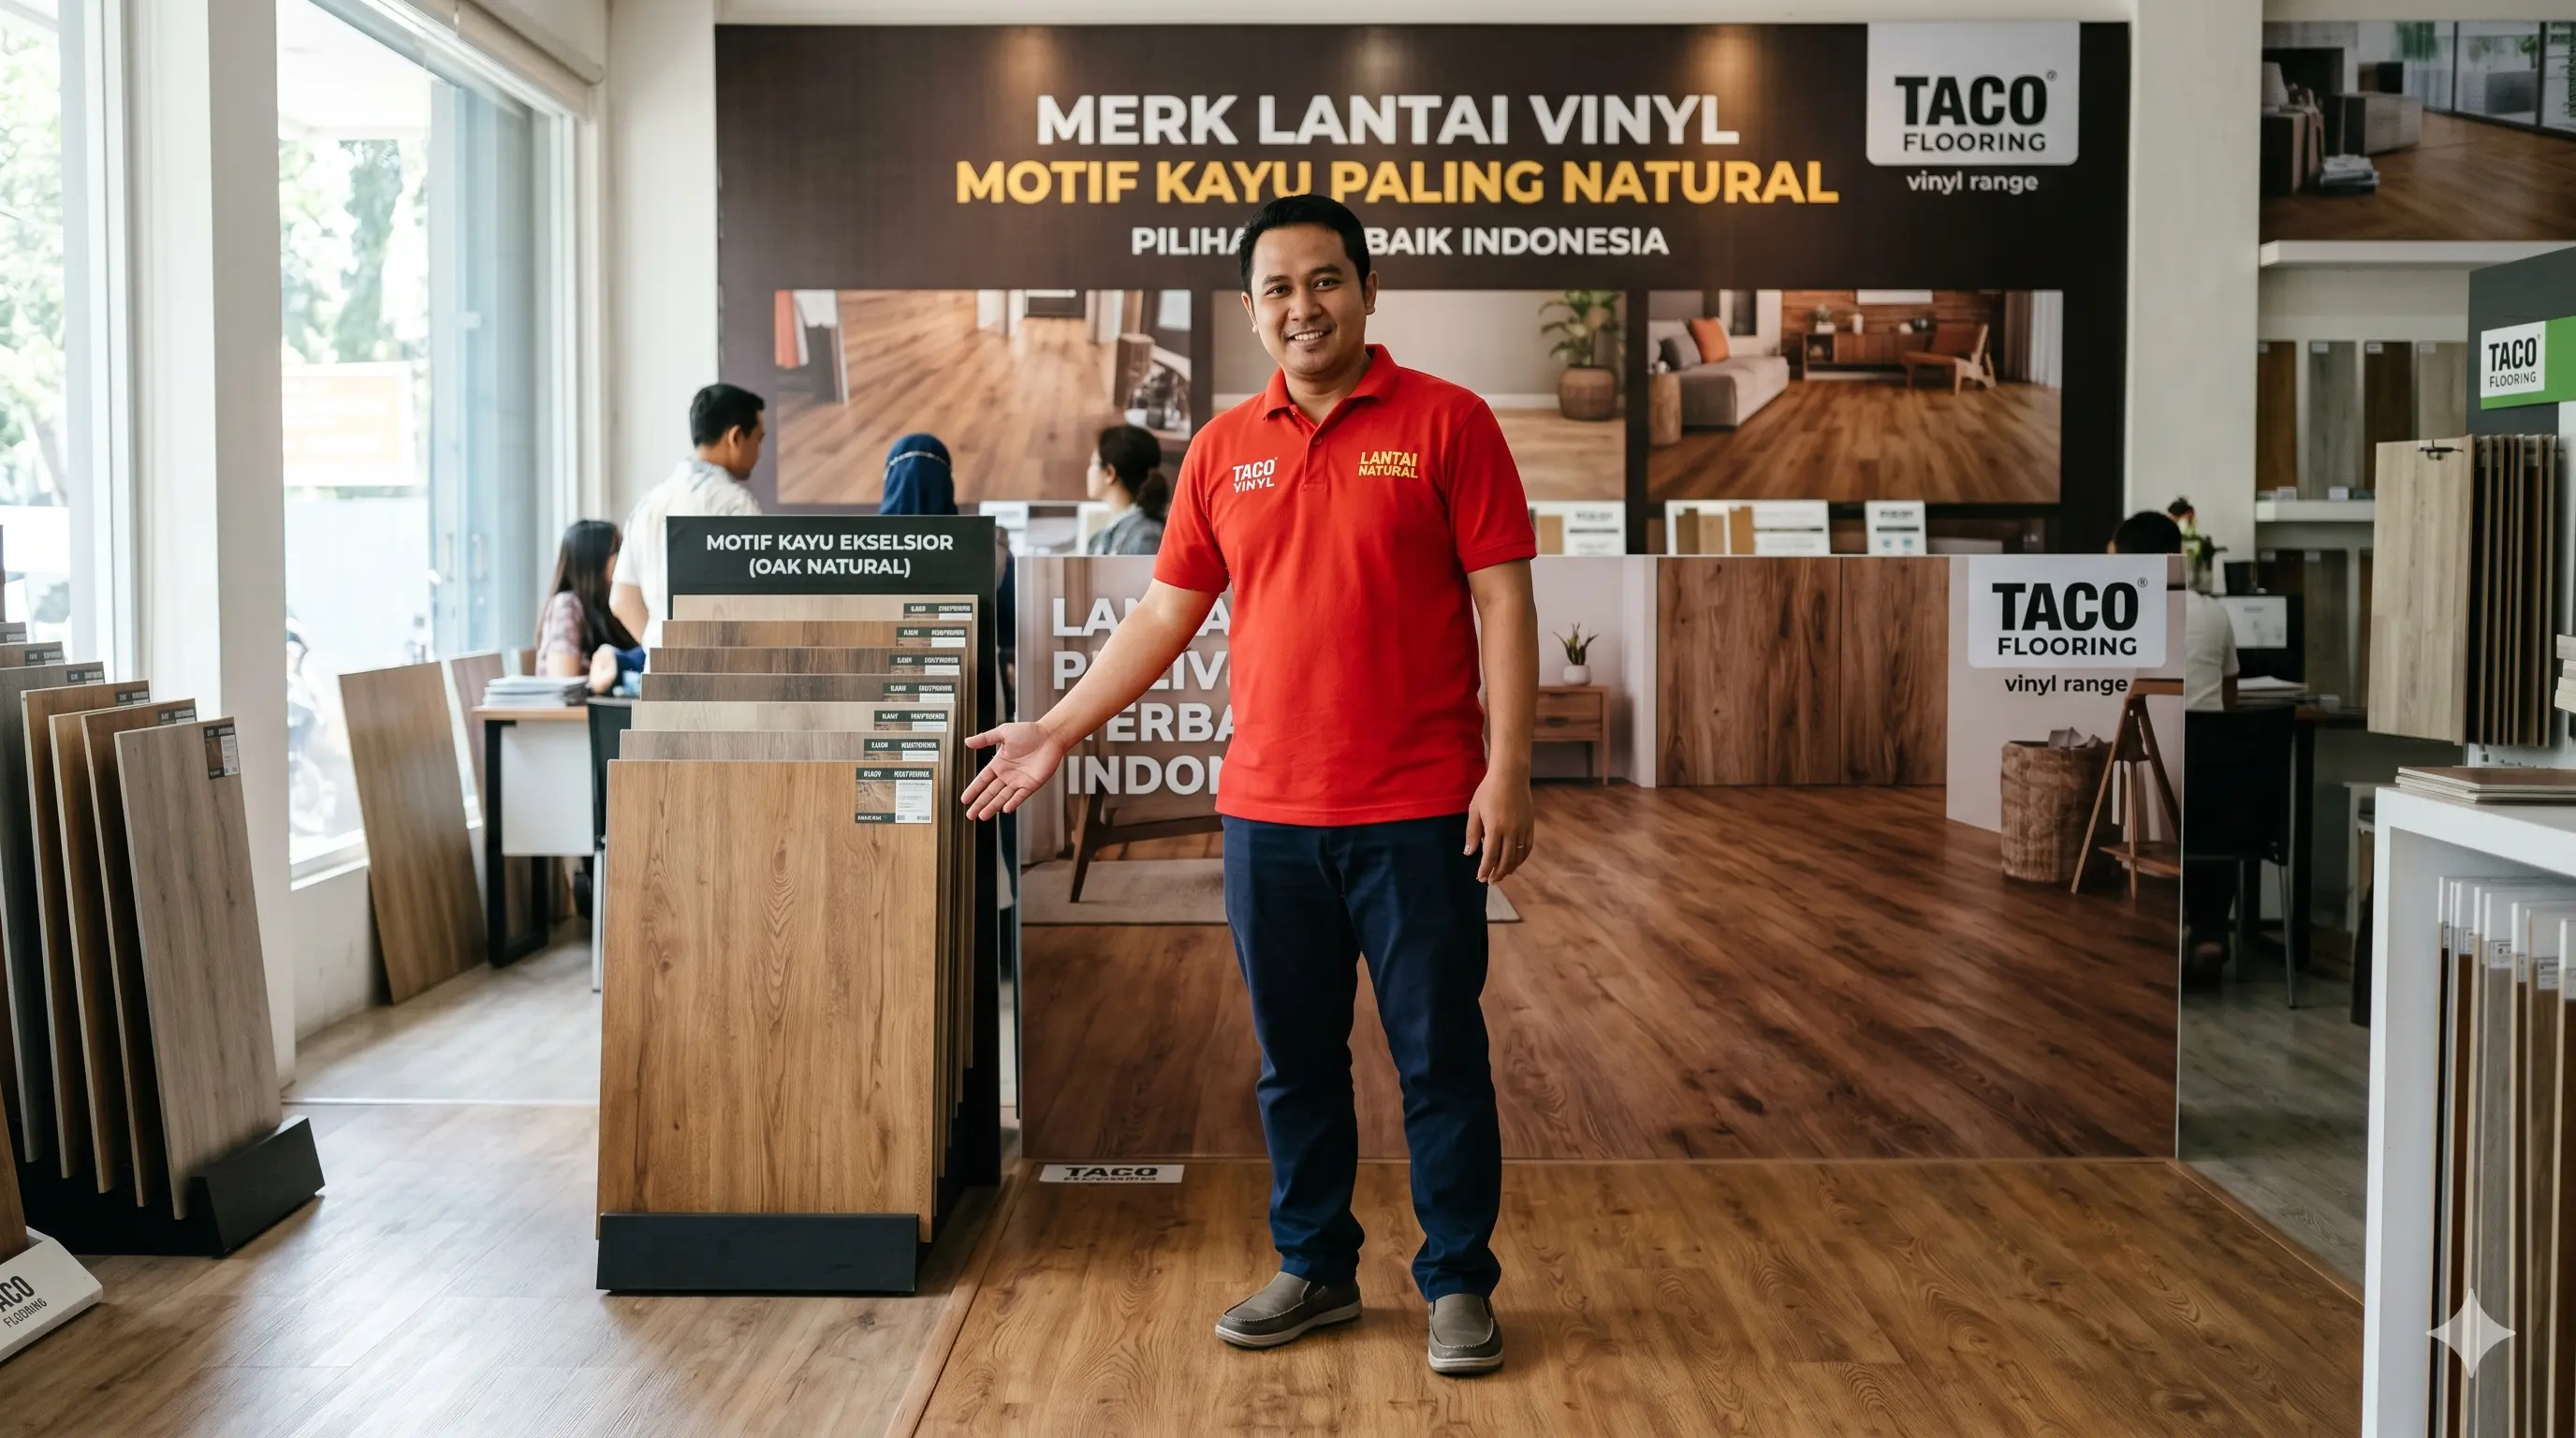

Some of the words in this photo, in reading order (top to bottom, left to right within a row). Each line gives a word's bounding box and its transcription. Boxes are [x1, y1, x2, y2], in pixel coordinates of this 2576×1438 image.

[1895, 75, 2048, 126] TACO
[1037, 95, 1238, 145] MERK
[1258, 95, 1509, 145] LANTAI
[1530, 95, 1740, 145] VINYL
[1904, 133, 2046, 152] FLOORING
[956, 160, 1139, 204] MOTIF
[1157, 160, 1310, 203] KAYU
[1331, 160, 1544, 204] PALING
[1563, 160, 1838, 204] NATURAL
[1906, 170, 1963, 196] vinyl
[1969, 175, 2039, 196] range
[1365, 227, 1453, 256] BAIK
[1463, 227, 1670, 256] INDONESIA
[2489, 337, 2537, 373] TACO
[2489, 371, 2537, 388] FLOORING
[1359, 451, 1418, 467] LANTAI
[1232, 459, 1276, 482] TACO
[1358, 465, 1418, 478] NATURAL
[1233, 476, 1275, 493] VINYL
[707, 534, 772, 551] MOTIF
[778, 534, 834, 551] KAYU
[841, 534, 954, 551] EKSELSIOR
[749, 558, 802, 578] (OAK
[808, 558, 911, 578] NATURAL)
[1992, 581, 2139, 632] TACO
[1998, 637, 2137, 656] FLOORING
[2005, 674, 2056, 696] vinyl
[2064, 678, 2128, 696] range
